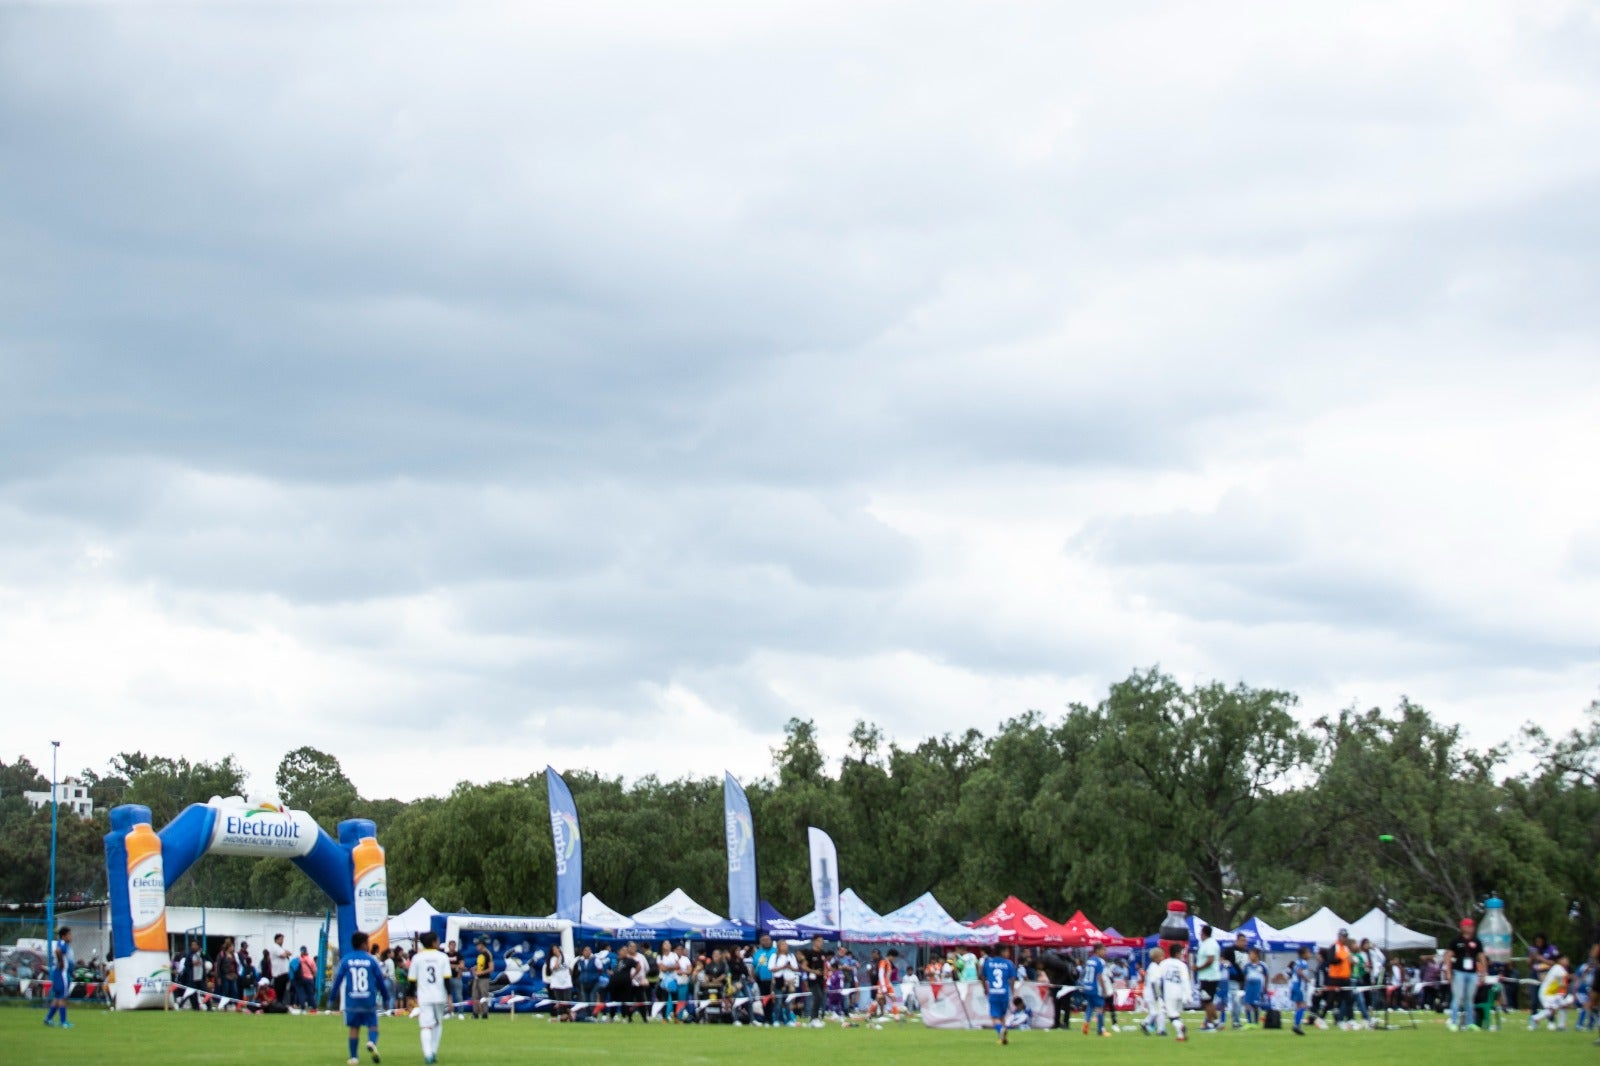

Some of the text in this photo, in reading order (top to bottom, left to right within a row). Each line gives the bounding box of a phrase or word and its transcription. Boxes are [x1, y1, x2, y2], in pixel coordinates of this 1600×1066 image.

[227, 816, 300, 838] Electrolit
[349, 967, 369, 992] 18
[427, 966, 436, 984] 3
[992, 968, 1003, 989] 3
